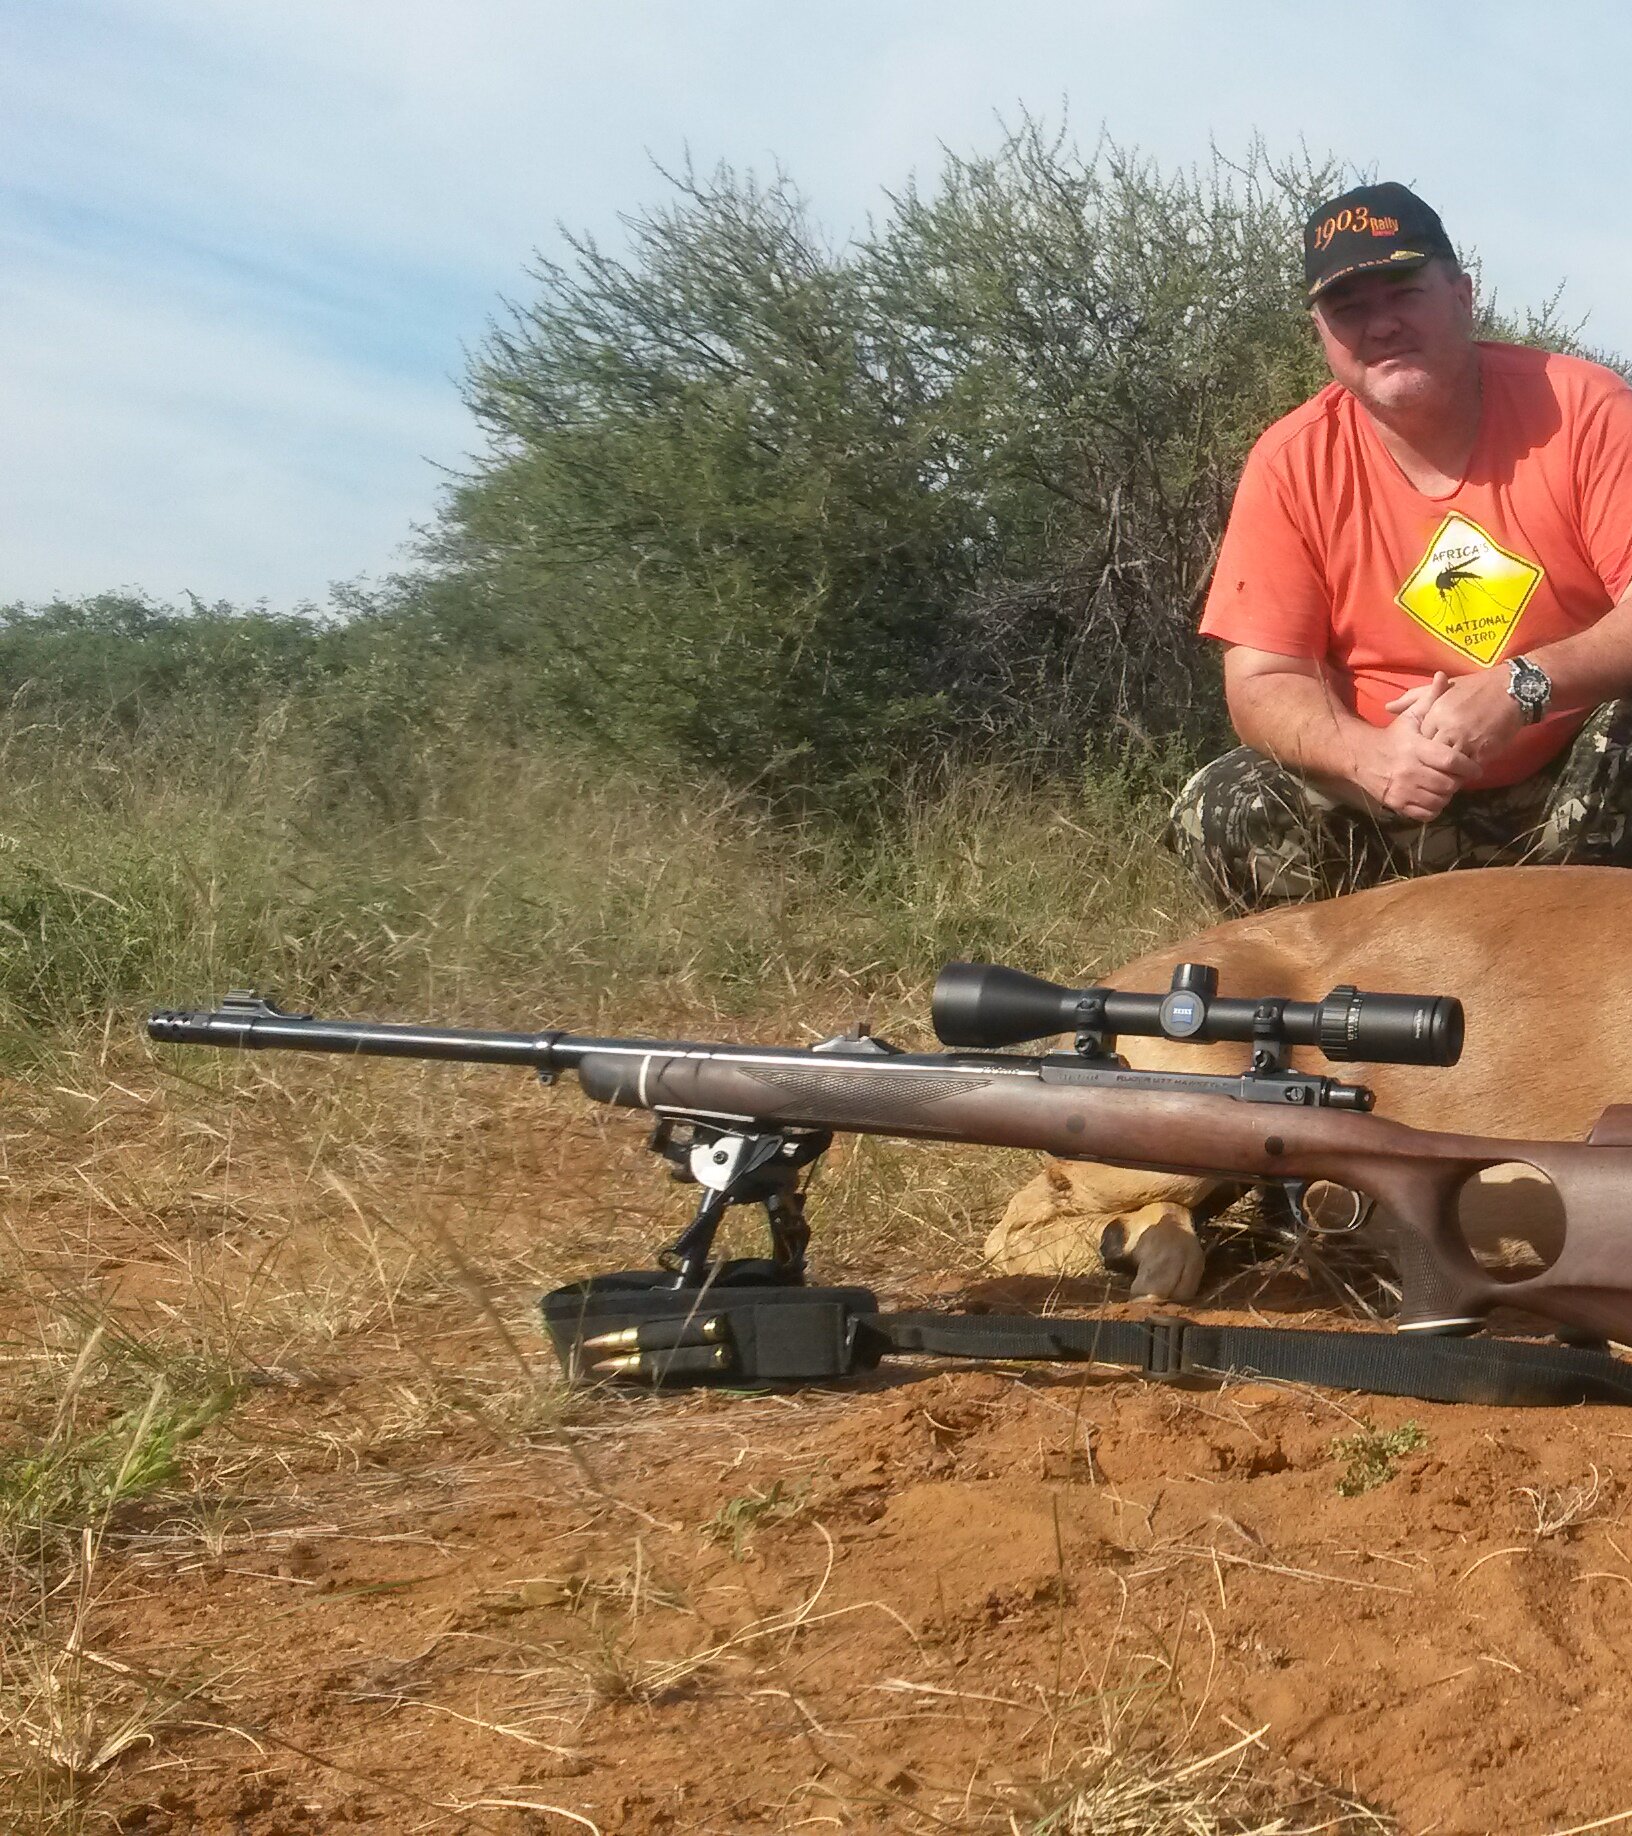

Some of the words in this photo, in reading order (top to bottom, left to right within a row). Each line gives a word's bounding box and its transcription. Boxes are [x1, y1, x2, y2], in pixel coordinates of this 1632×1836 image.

[1313, 207, 1368, 251] 1903
[1370, 217, 1399, 231] Rally
[1432, 543, 1490, 562] AFRICA'S
[1445, 615, 1511, 634] NATIONAL
[1464, 631, 1496, 646] BIRD
